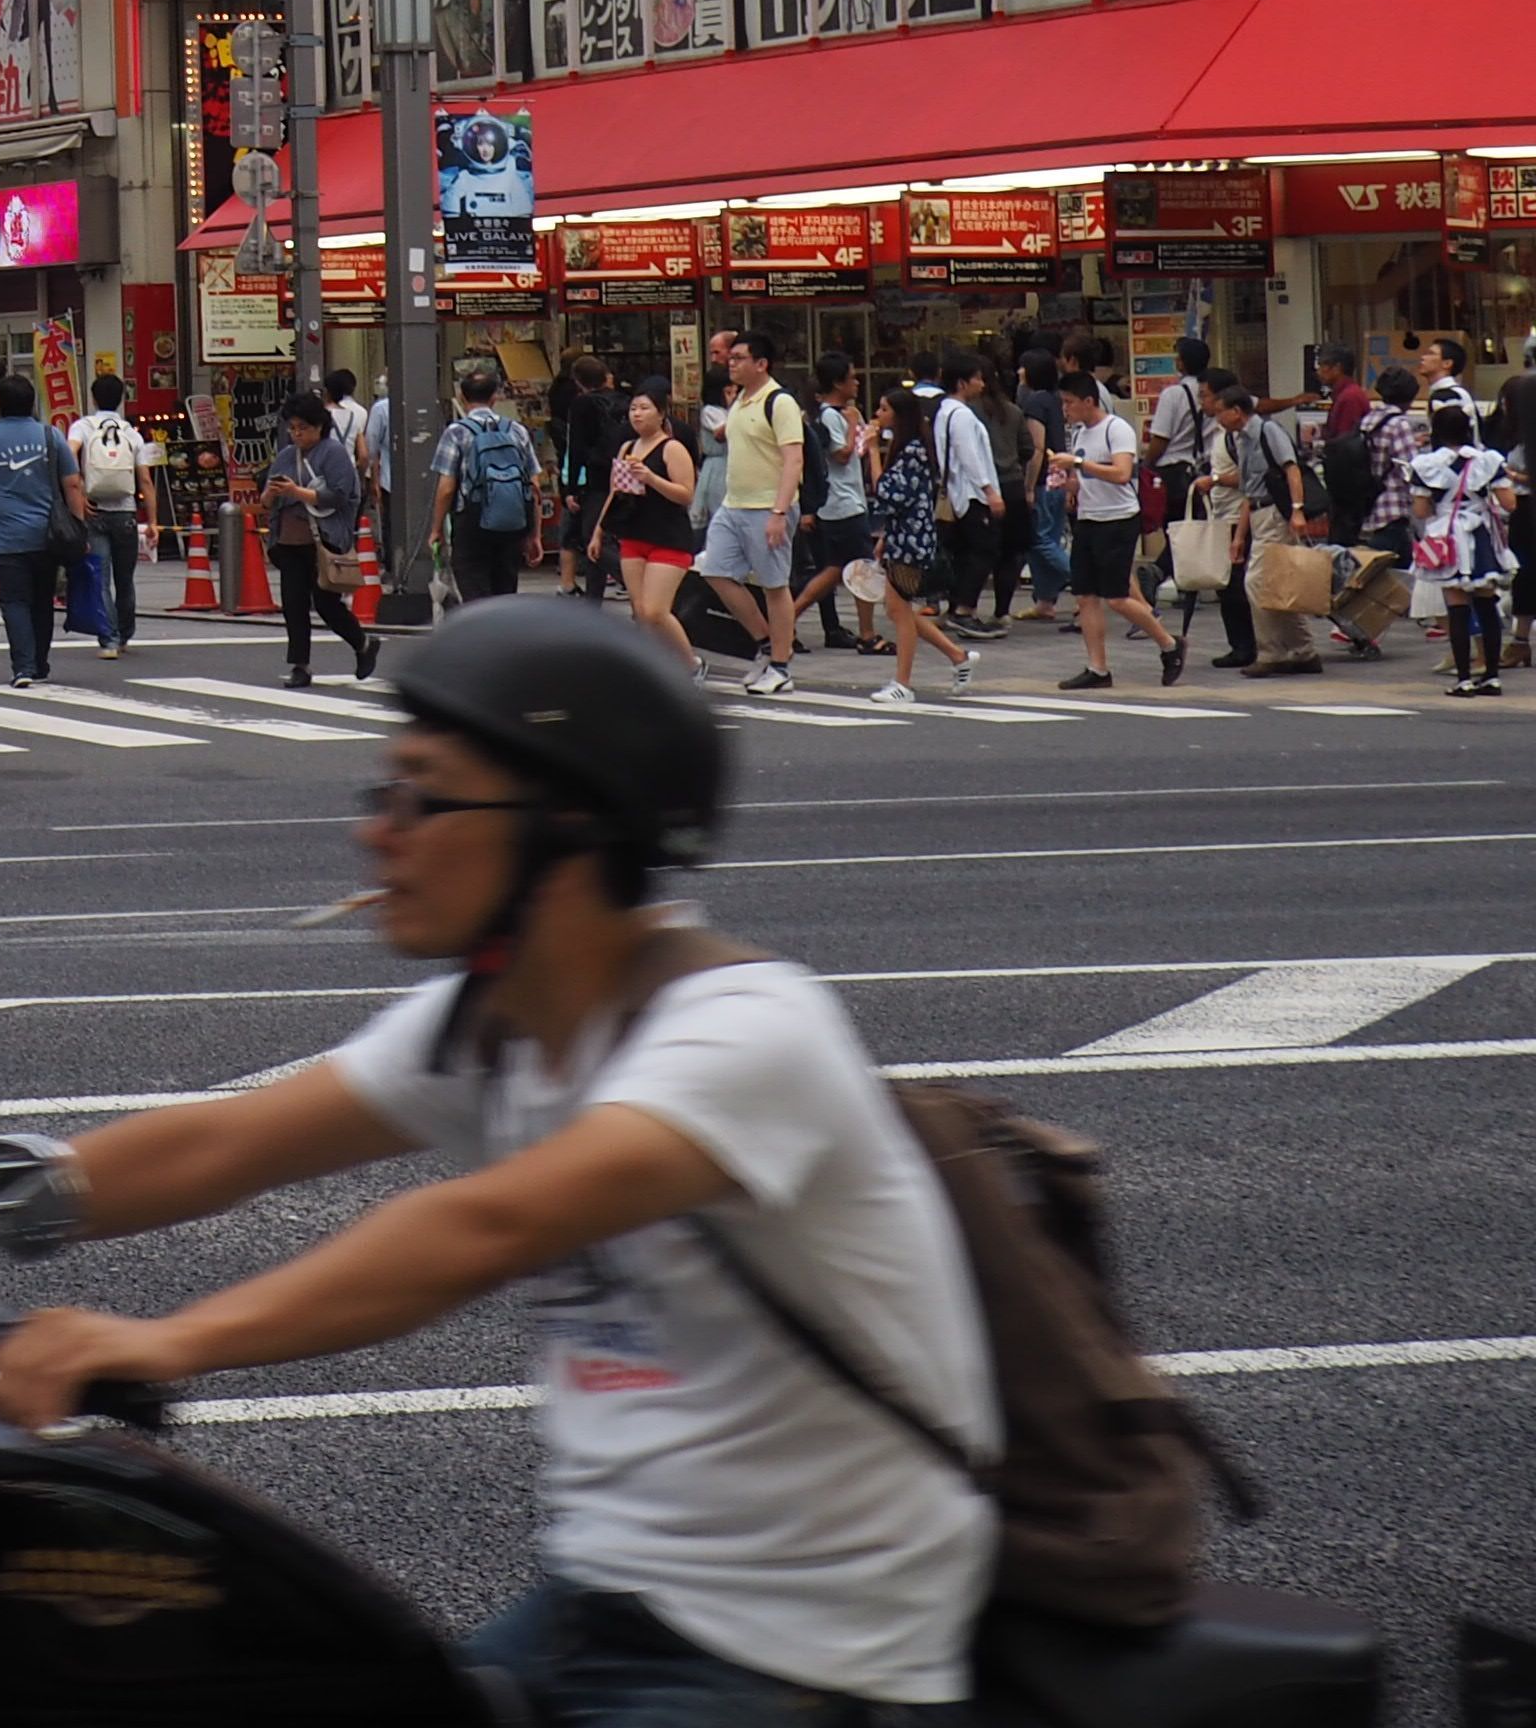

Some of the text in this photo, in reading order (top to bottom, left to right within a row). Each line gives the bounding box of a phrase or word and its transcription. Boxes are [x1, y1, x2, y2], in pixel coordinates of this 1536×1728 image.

[445, 229, 533, 242] LIVE GALAXY
[1231, 215, 1264, 238] 3F
[1020, 232, 1052, 255] 4F
[664, 257, 693, 276] 5F
[834, 246, 864, 267] 4F
[516, 273, 543, 288] 6F
